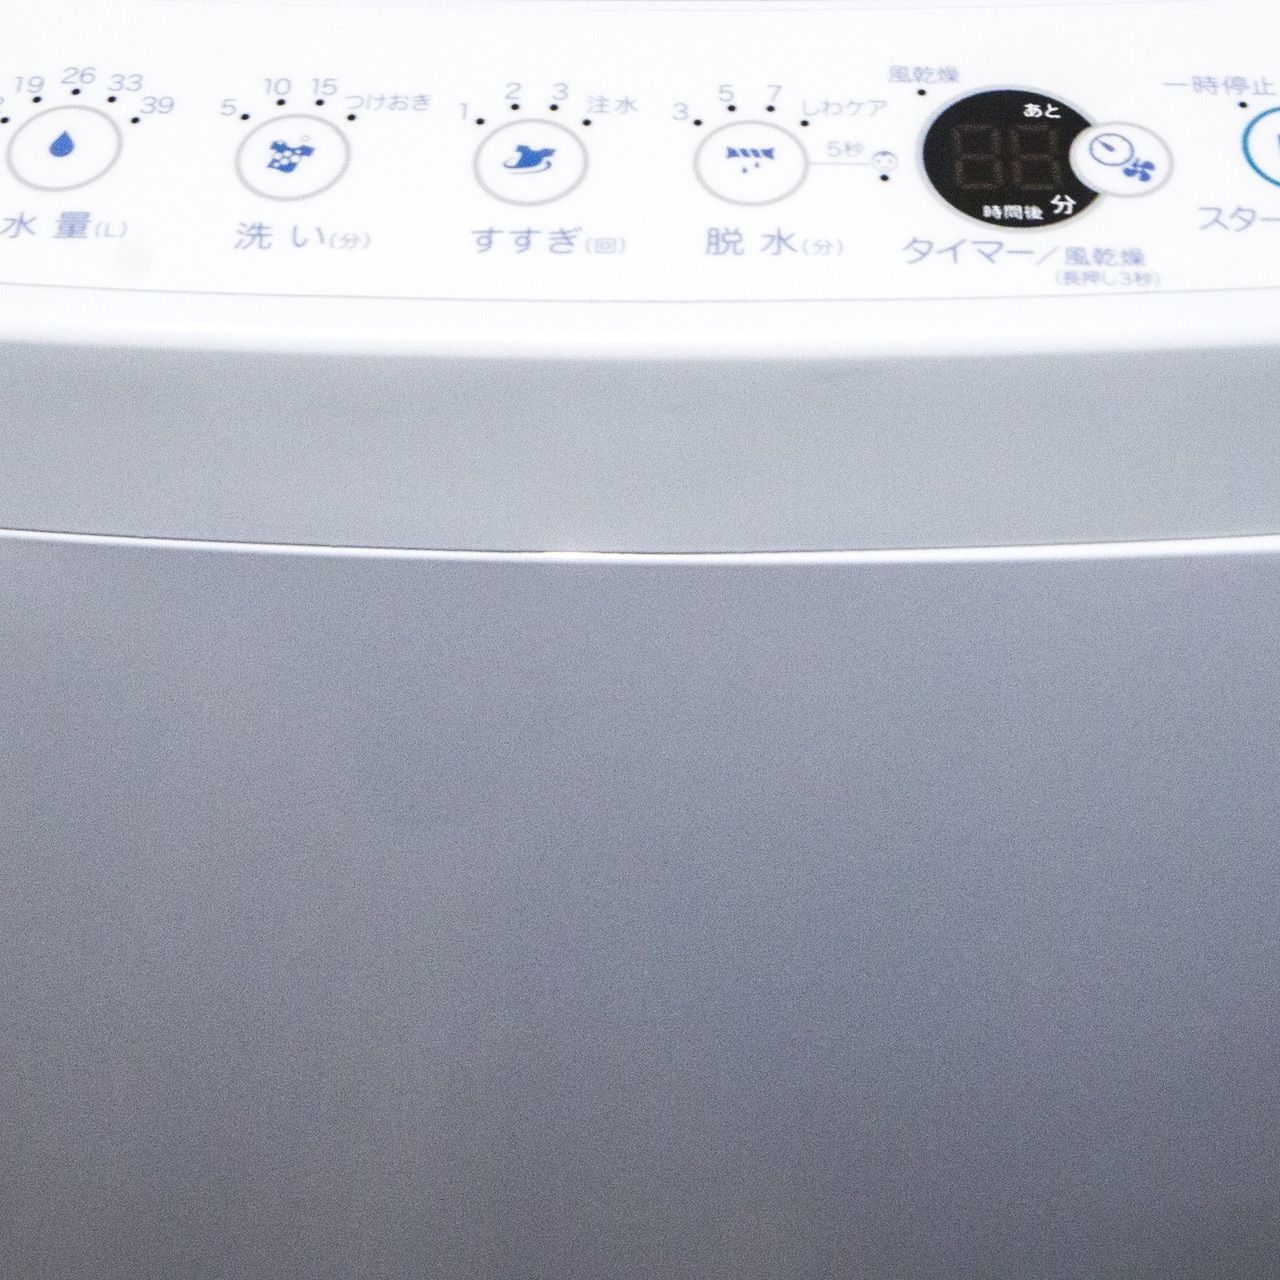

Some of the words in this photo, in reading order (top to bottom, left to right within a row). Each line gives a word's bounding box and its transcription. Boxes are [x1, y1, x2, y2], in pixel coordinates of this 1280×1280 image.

[14, 75, 45, 94] 19
[61, 66, 97, 86] 26
[109, 73, 144, 93] 33
[888, 65, 962, 85] 風乾燥
[263, 78, 293, 97] 10
[311, 78, 339, 97] 15
[504, 82, 522, 102] 2
[552, 82, 570, 102] 3
[717, 84, 735, 102] 5
[767, 84, 784, 102] 7
[1162, 75, 1277, 97] 一時停止
[141, 96, 176, 116] 39
[220, 99, 237, 118] 5
[344, 93, 432, 113] つけおき
[459, 102, 469, 121] 1
[586, 94, 639, 116] 注水
[671, 102, 690, 122] 3
[801, 98, 888, 118] しわケア
[1022, 102, 1063, 120] あと
[826, 140, 867, 158] 5秒
[982, 204, 1045, 221] 時間後
[1051, 194, 1077, 216] 分
